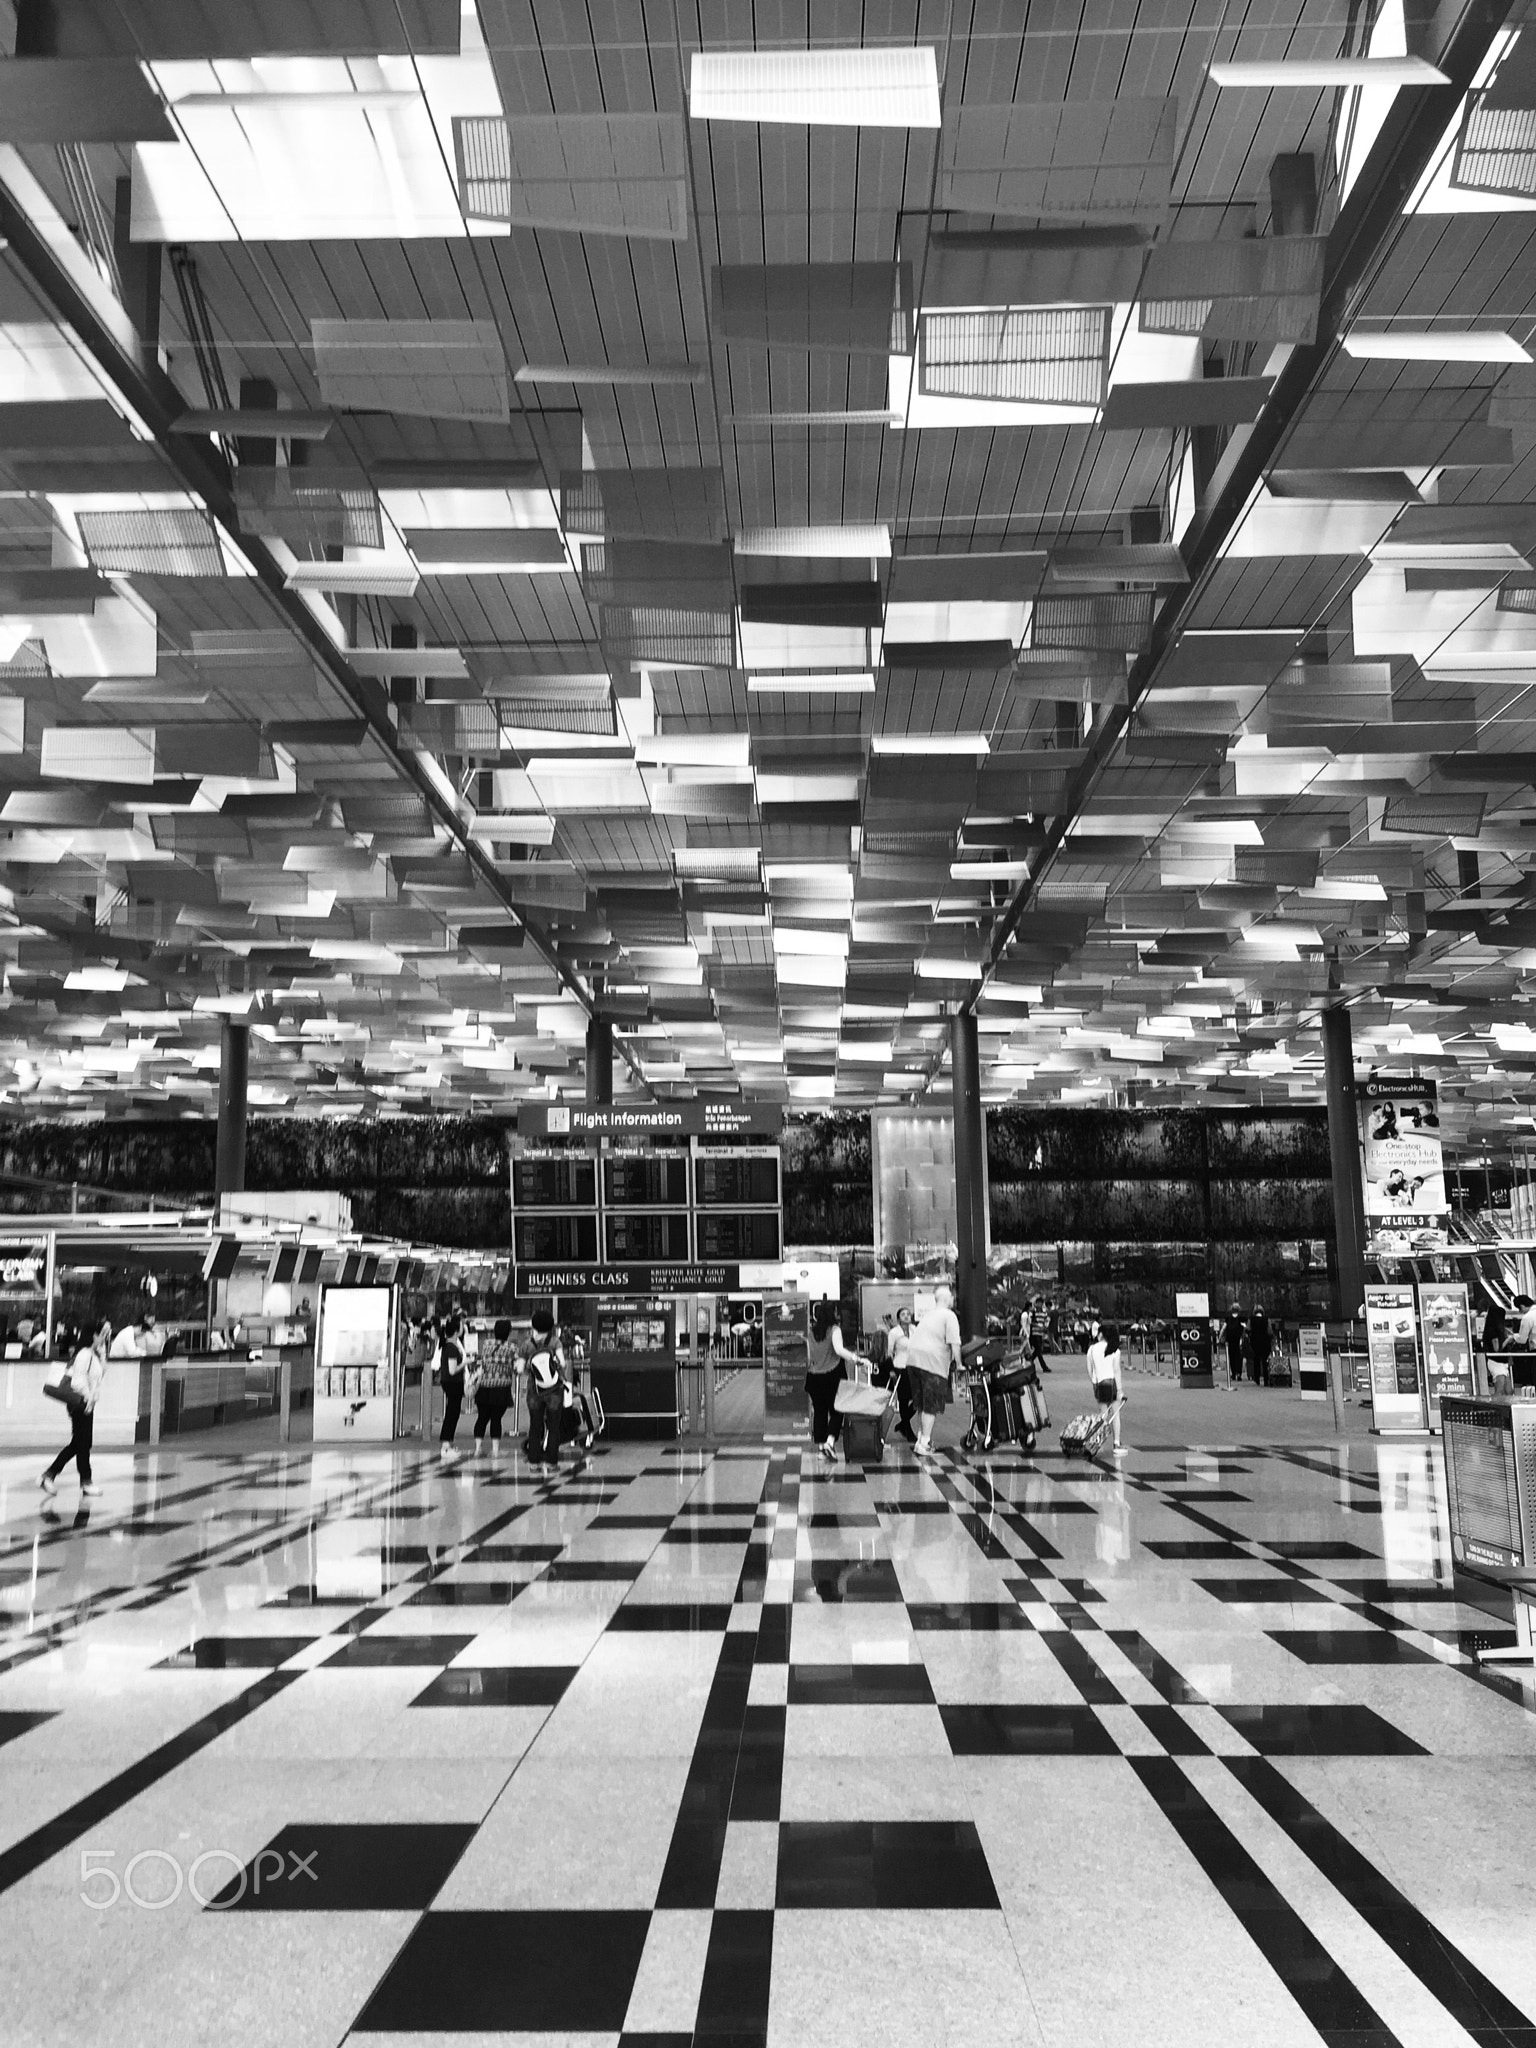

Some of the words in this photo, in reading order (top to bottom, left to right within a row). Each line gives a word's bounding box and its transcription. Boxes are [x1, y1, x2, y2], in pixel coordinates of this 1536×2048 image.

[573, 1112, 608, 1129] Flight
[611, 1111, 682, 1126] Information
[1381, 1217, 1392, 1226] AT
[1392, 1216, 1417, 1226] LEVEL
[1418, 1216, 1424, 1225] 3
[650, 1267, 684, 1276] KRISFLYER
[686, 1267, 703, 1276] ELITE
[706, 1267, 726, 1276] GOLD
[528, 1272, 586, 1286] BUSINESS
[592, 1271, 629, 1285] CLASS
[650, 1276, 667, 1284] STAR
[670, 1276, 701, 1284] ALLIANCE
[704, 1275, 724, 1284] GOLD
[1368, 1294, 1384, 1302] Apply
[1182, 1356, 1199, 1369] 10
[1436, 1383, 1446, 1391] 90
[1447, 1383, 1466, 1391] mins
